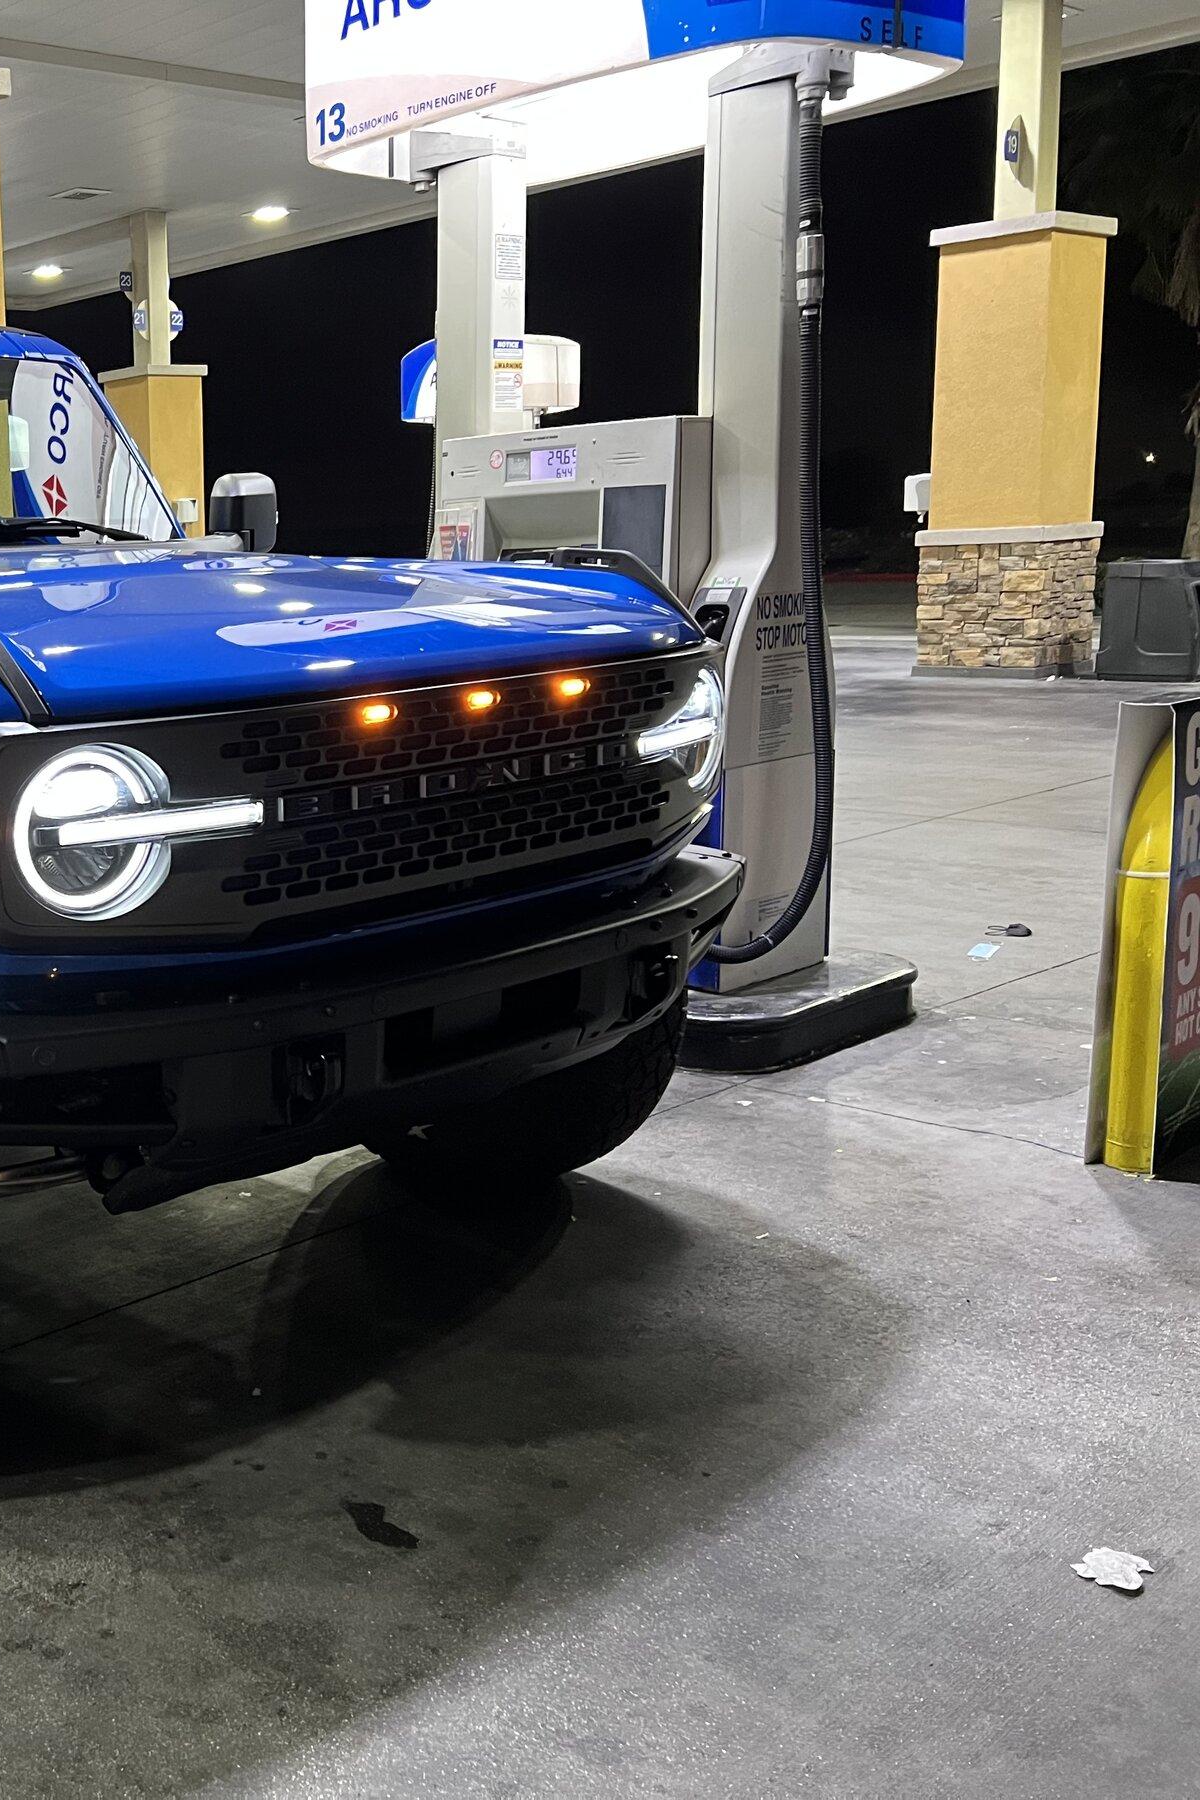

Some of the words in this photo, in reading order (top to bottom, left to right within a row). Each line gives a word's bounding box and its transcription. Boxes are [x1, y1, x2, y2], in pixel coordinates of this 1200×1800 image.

[860, 16, 924, 49] SELF
[315, 102, 346, 147] 13
[346, 125, 358, 138] NO
[359, 110, 399, 133] SMOKING
[407, 101, 434, 117] TURN
[434, 88, 473, 108] ENGINE
[475, 82, 497, 98] OFF
[1007, 135, 1017, 154] 19
[120, 274, 132, 287] 23
[133, 312, 145, 325] 21
[171, 313, 183, 326] 22
[497, 362, 523, 370] WARNING
[756, 596, 772, 621] NO
[773, 592, 804, 618] SMOKI
[755, 626, 781, 651] STOP
[782, 622, 808, 648] MOTO
[277, 743, 627, 823] BRONCO
